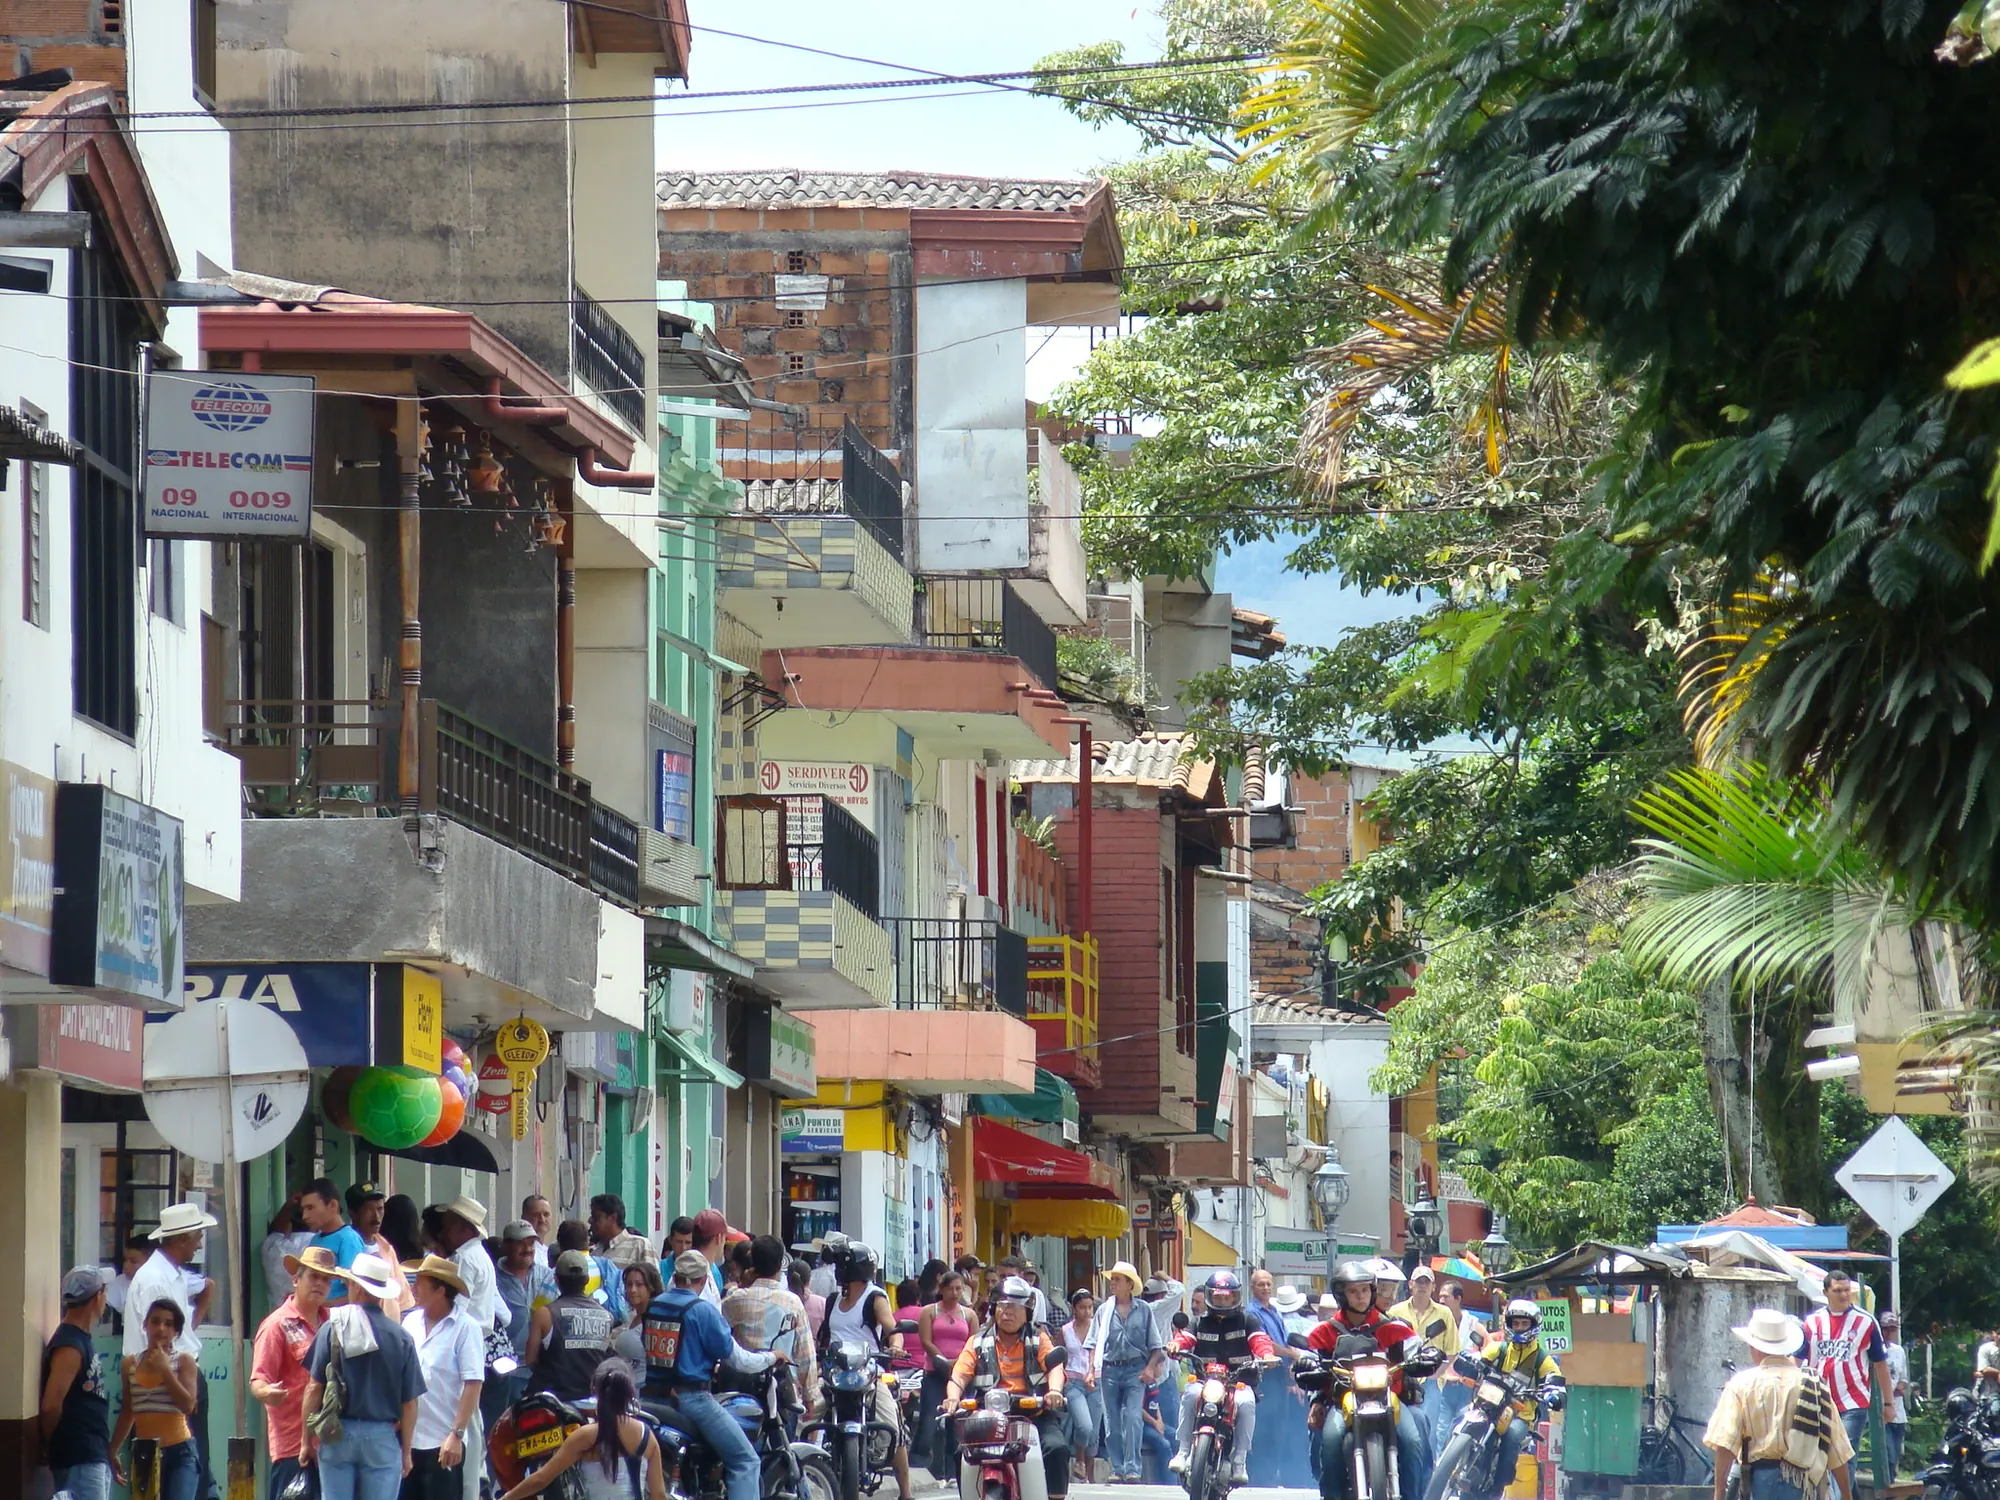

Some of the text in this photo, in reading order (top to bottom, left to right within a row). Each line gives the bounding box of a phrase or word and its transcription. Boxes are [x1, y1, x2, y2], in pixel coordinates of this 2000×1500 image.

[194, 400, 266, 413] TELECOM
[178, 450, 282, 469] TELECOM
[162, 488, 291, 508] 09 009
[151, 508, 299, 522] NACIONAL INTERNACIONAL
[787, 767, 846, 780] SERDIVER
[788, 781, 847, 790] Servicios Diversos
[847, 796, 868, 805] HOYOS
[517, 1098, 525, 1136] MINUTO
[807, 1118, 831, 1127] PUNTO
[832, 1118, 842, 1126] DE
[1306, 1242, 1330, 1256] GAN
[1542, 1306, 1565, 1317] UTOS
[1541, 1320, 1565, 1332] ULAR
[1546, 1337, 1567, 1350] 150
